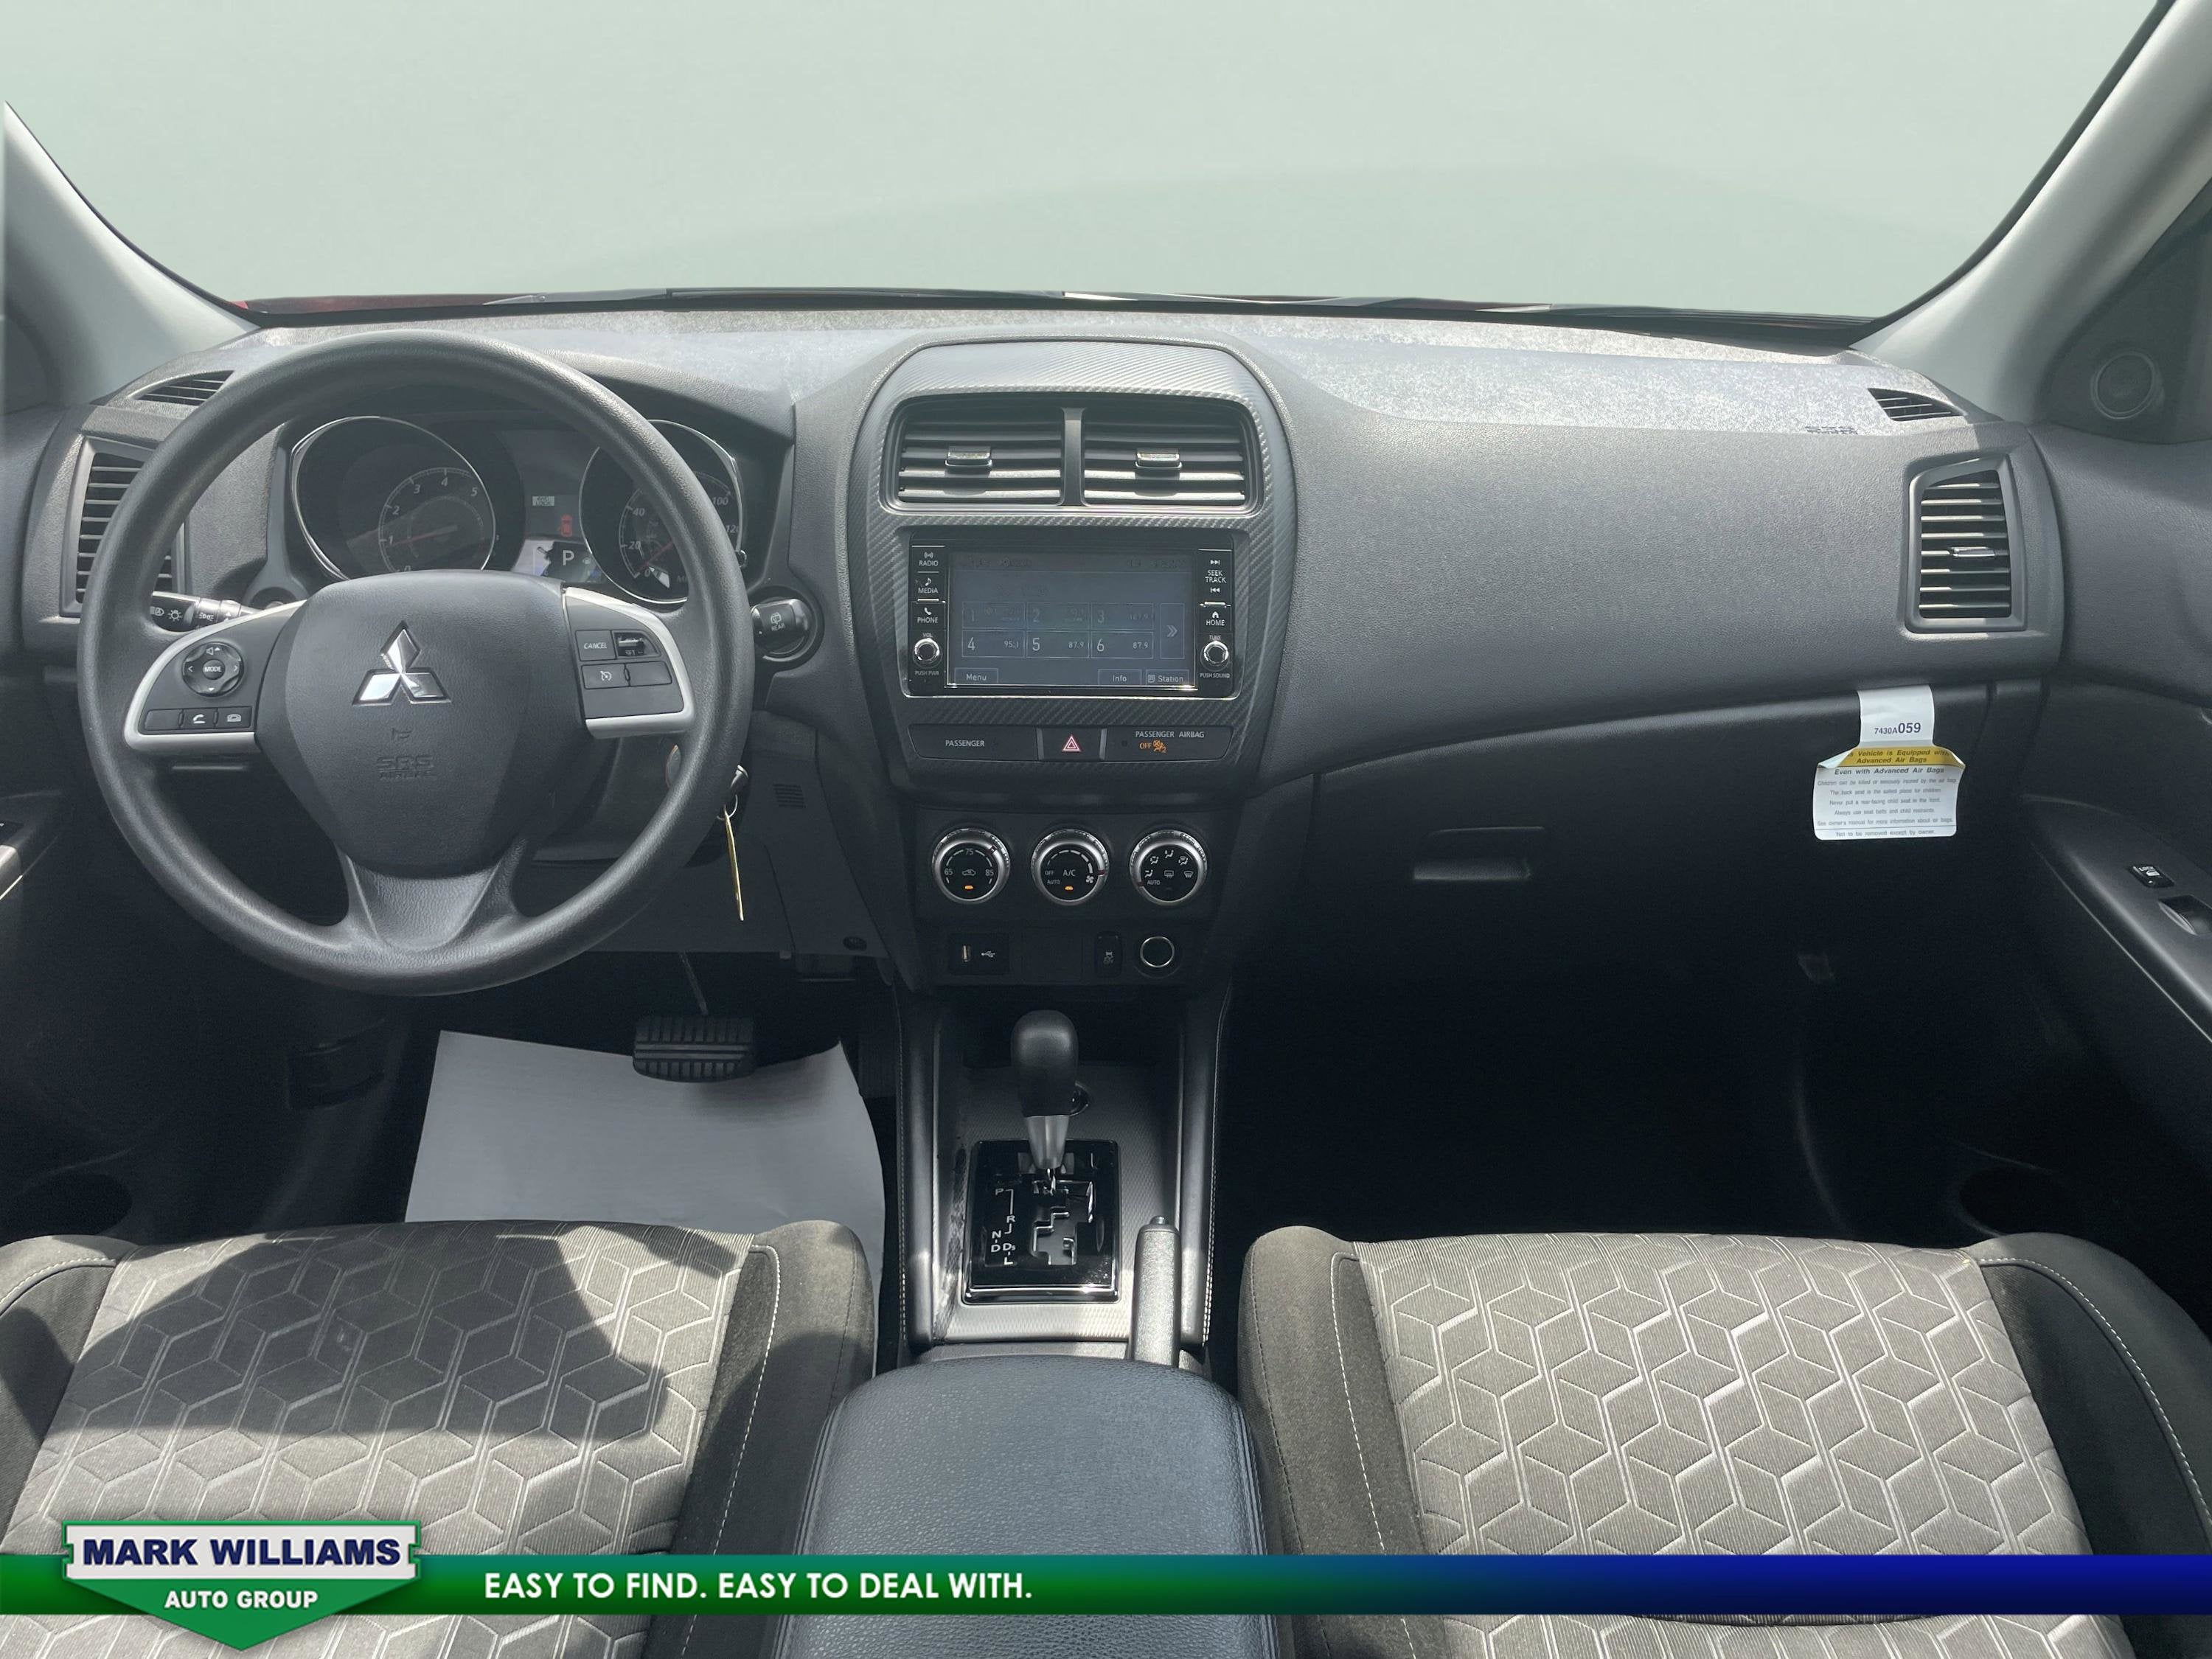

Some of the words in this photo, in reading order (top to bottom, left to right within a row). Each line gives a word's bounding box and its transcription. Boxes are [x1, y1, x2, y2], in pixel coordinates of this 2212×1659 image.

[441, 477, 448, 487] 4
[414, 484, 421, 494] 3
[470, 487, 478, 496] 5
[712, 496, 729, 506] 100
[392, 505, 400, 515] 2
[633, 507, 645, 517] 40
[388, 535, 394, 545] 1
[563, 550, 575, 566] P
[584, 641, 608, 650] CANCEL
[967, 637, 976, 650] 4
[1004, 641, 1019, 649] 95.1
[1032, 637, 1040, 651] 5
[1068, 641, 1084, 650] 87.9
[1096, 638, 1105, 652] 6
[1133, 641, 1149, 650] 87.9
[966, 673, 987, 681] Menu
[1113, 675, 1127, 683] Info
[1158, 675, 1184, 684] Station
[1874, 722, 1921, 734] 7430A059
[1139, 742, 1152, 750] OFF
[1896, 749, 1930, 757] Equipped
[1006, 1215, 1016, 1223] R
[992, 1230, 1001, 1239] N
[991, 1244, 1001, 1253] D
[1004, 1256, 1014, 1265] L
